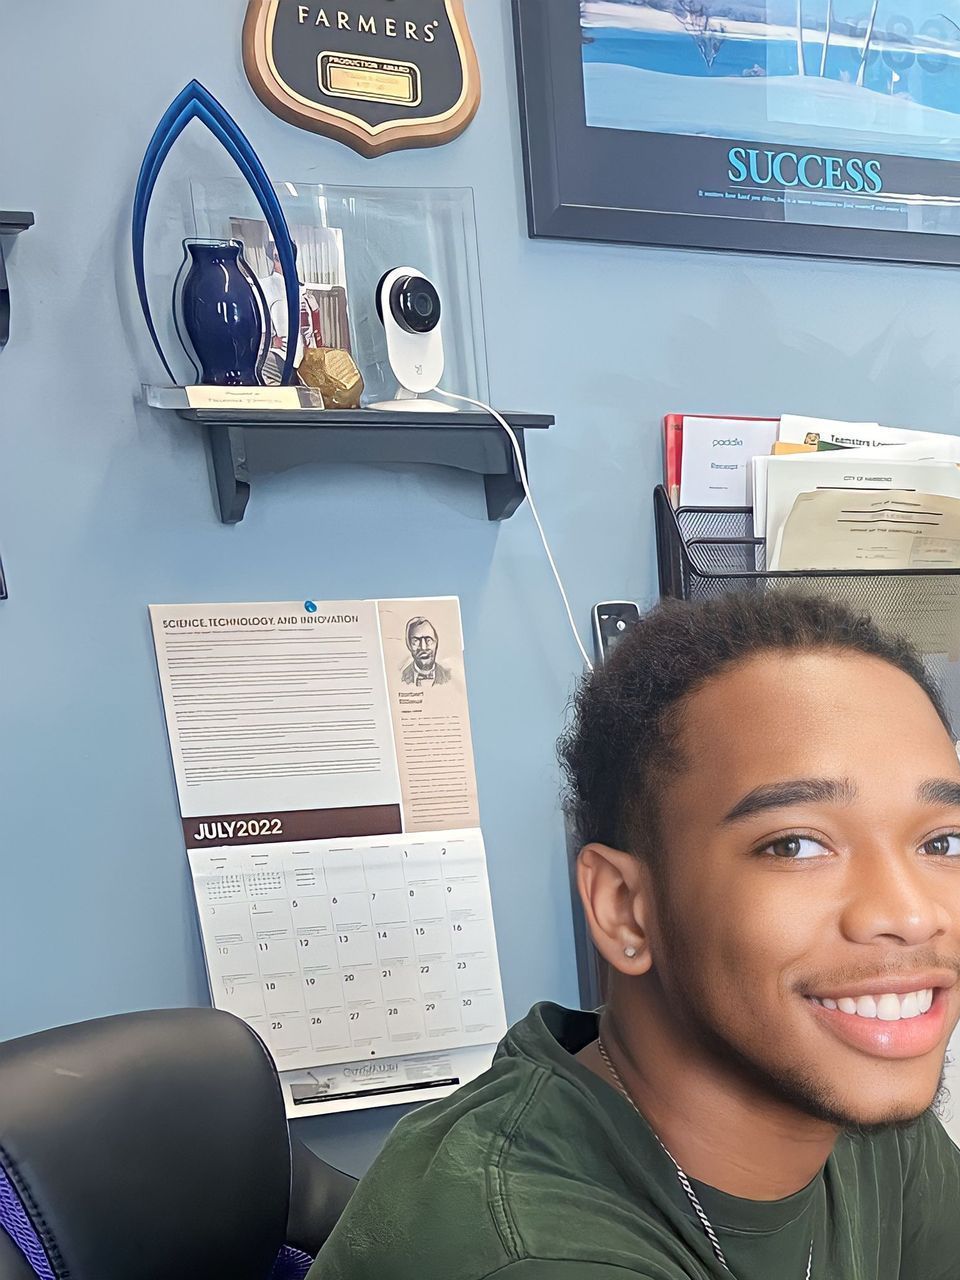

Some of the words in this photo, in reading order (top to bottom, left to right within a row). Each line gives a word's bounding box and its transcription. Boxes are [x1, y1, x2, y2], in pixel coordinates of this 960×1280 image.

[298, 5, 437, 42] FARMERS
[728, 147, 883, 194] SUCCESS
[277, 616, 298, 626] AND
[259, 943, 269, 951] 11
[378, 931, 387, 939] 14
[344, 974, 355, 982] 20
[349, 1012, 360, 1020] 27
